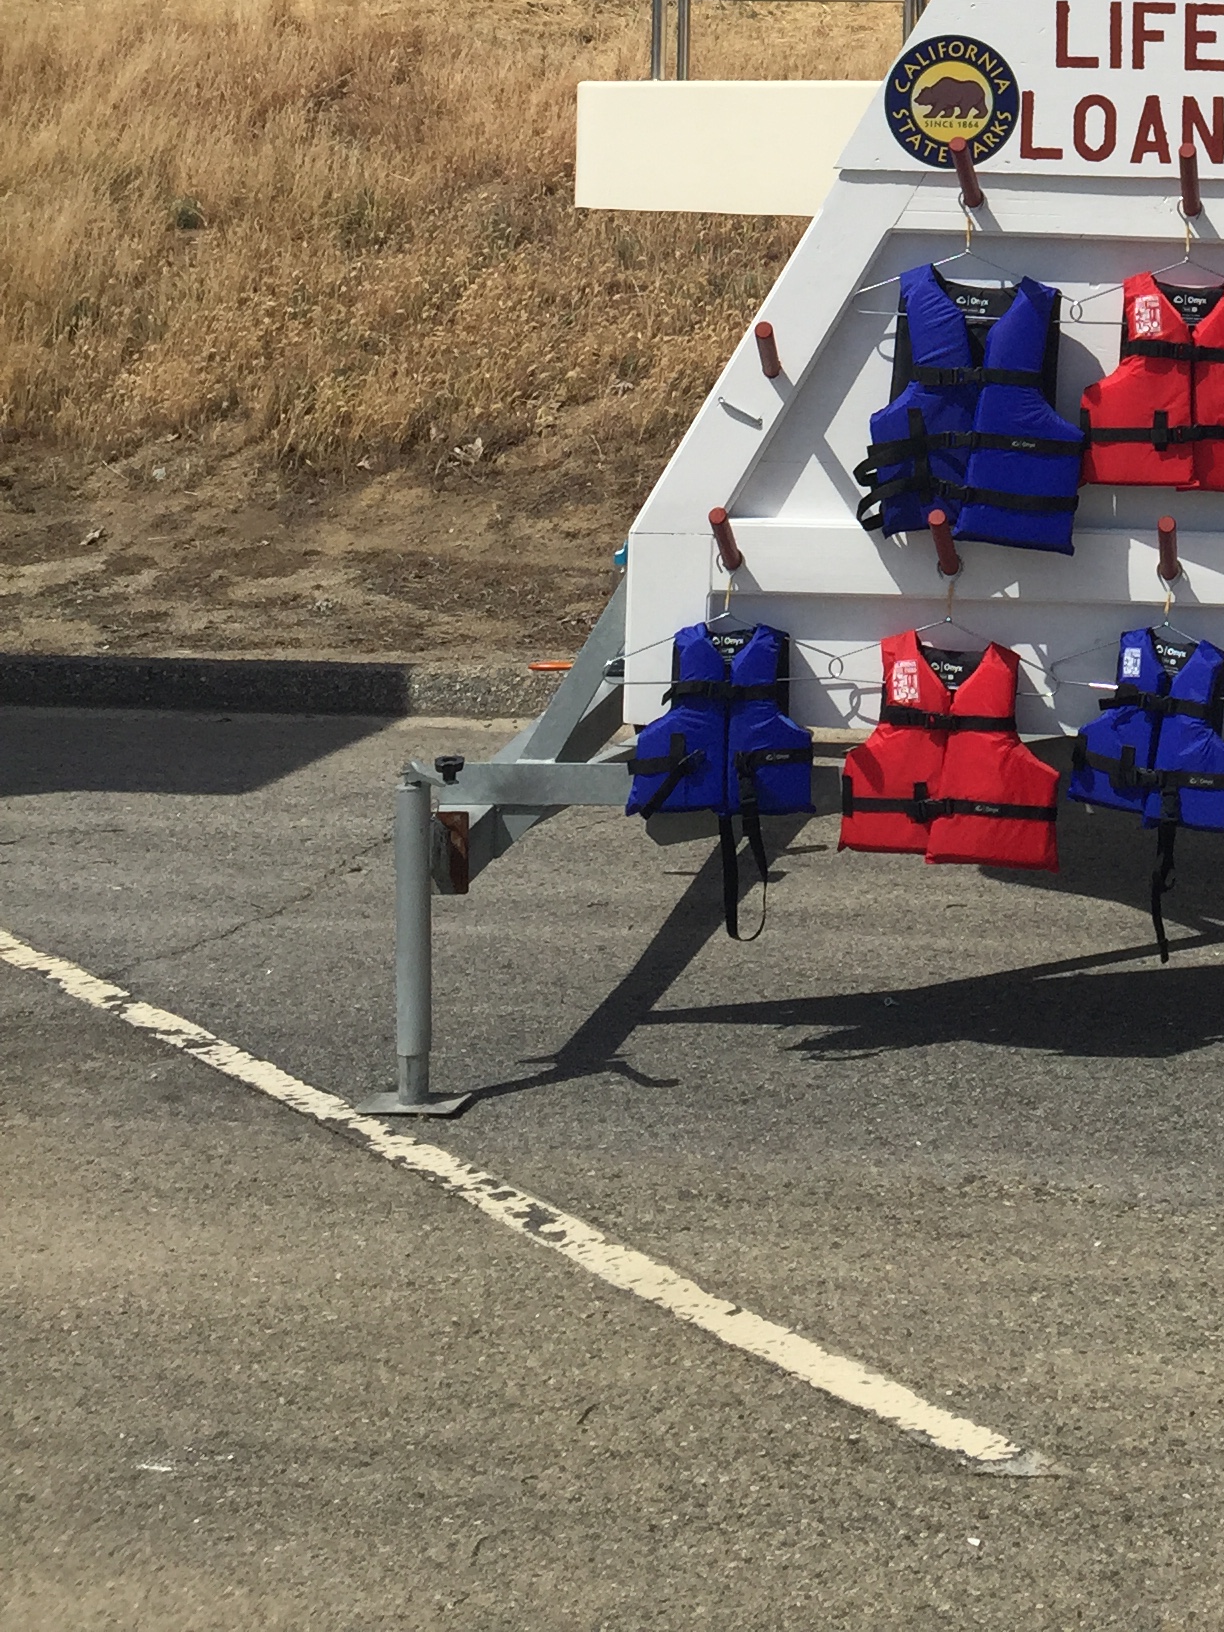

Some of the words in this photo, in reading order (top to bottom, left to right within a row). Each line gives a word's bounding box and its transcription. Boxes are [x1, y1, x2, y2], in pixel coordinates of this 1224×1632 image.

[895, 41, 1011, 95] CALIFORNIA
[892, 108, 948, 163] STATE
[971, 111, 1012, 159] ARKS
[925, 120, 953, 128] SINCE
[1021, 91, 1224, 164] LOAN
[944, 663, 963, 672] Onyx
[1167, 648, 1187, 658] Onyx
